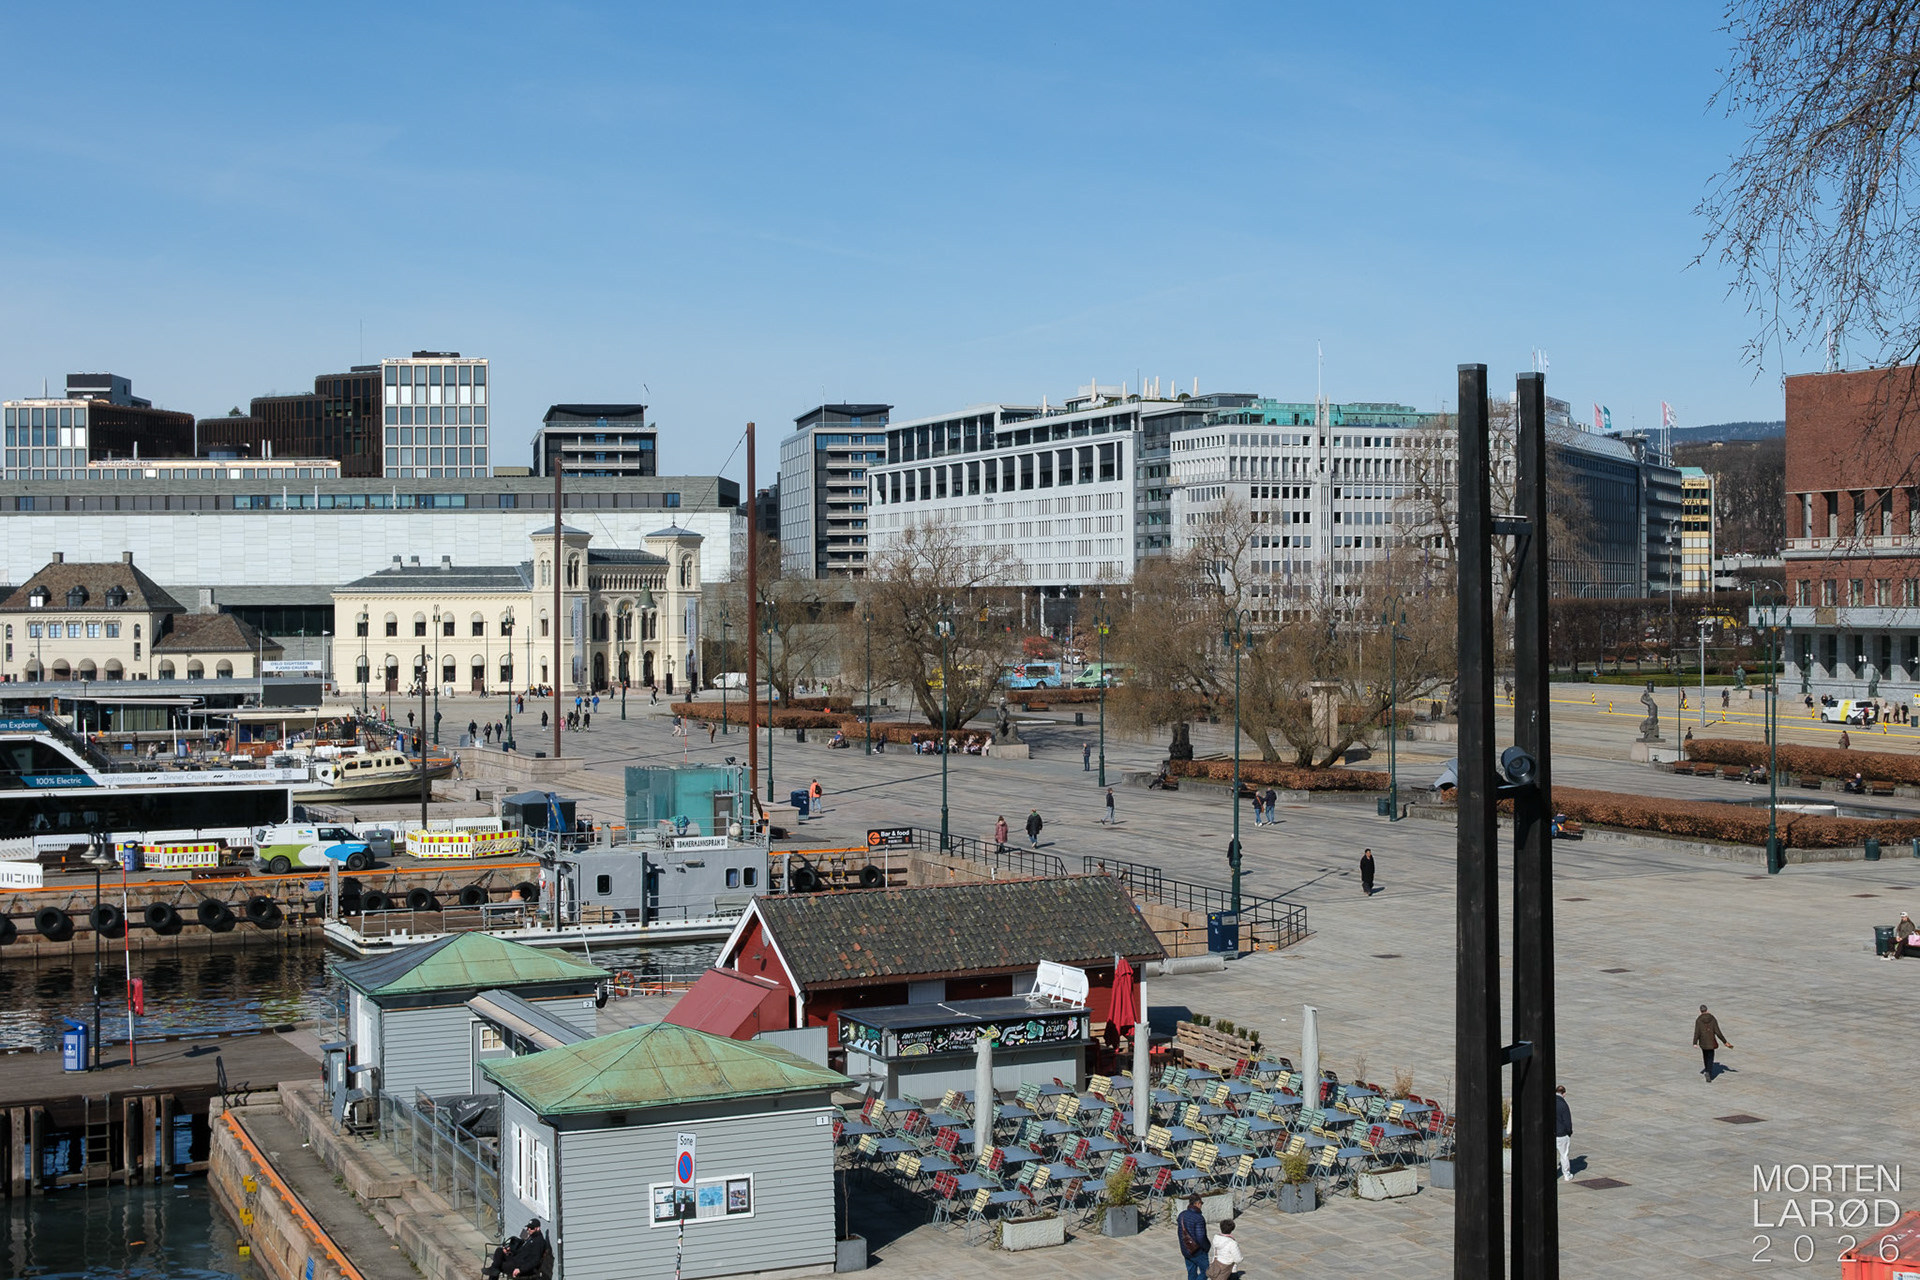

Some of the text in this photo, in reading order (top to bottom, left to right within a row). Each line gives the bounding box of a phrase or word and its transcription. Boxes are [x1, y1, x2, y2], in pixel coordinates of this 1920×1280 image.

[9, 721, 38, 729] Explorer
[36, 777, 55, 785] 100%
[102, 775, 141, 784] Sightseeing
[949, 1030, 976, 1041] PIZZA
[680, 1135, 693, 1146] Sone
